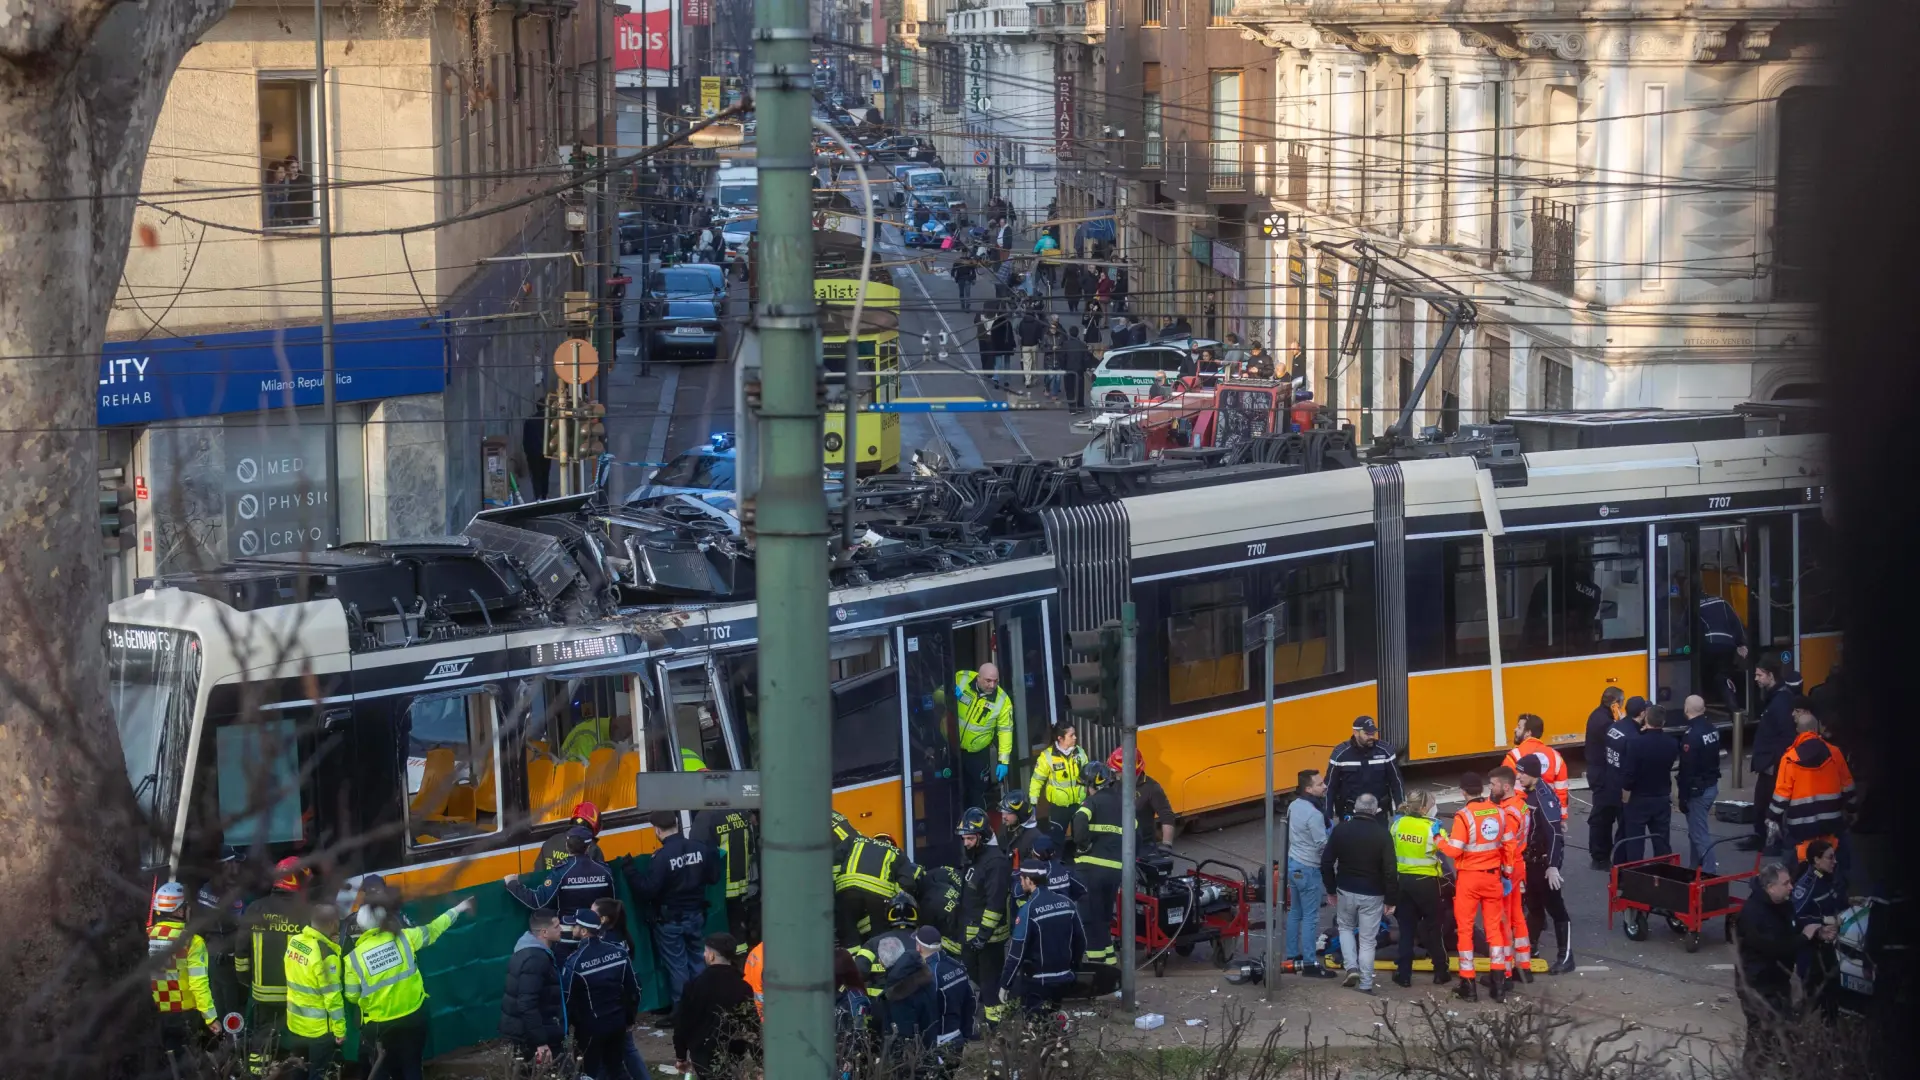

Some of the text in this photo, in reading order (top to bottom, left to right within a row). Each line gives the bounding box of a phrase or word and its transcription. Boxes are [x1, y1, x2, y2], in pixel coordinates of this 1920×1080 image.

[620, 27, 663, 50] ibis
[1060, 82, 1071, 150] BRIANZA
[261, 373, 352, 391] Milano Repulica
[102, 391, 151, 407] REHAB
[268, 458, 303, 475] MED
[1708, 496, 1732, 508] 7707
[270, 527, 321, 546] CRYO
[1247, 543, 1267, 557] 7707
[703, 625, 731, 640] 7707
[125, 630, 157, 650] GENOVA
[159, 632, 172, 651] FS
[438, 662, 459, 674] ATM
[716, 823, 731, 834] DEL
[1400, 834, 1423, 844] AREU
[1035, 904, 1054, 914] POLIZIA
[288, 952, 309, 966] AREU
[366, 945, 396, 960] DIRETTORE
[369, 950, 397, 965] SOCCORSI
[581, 951, 622, 969] POLIZIA LOCALE
[371, 956, 399, 970] SANITARI
